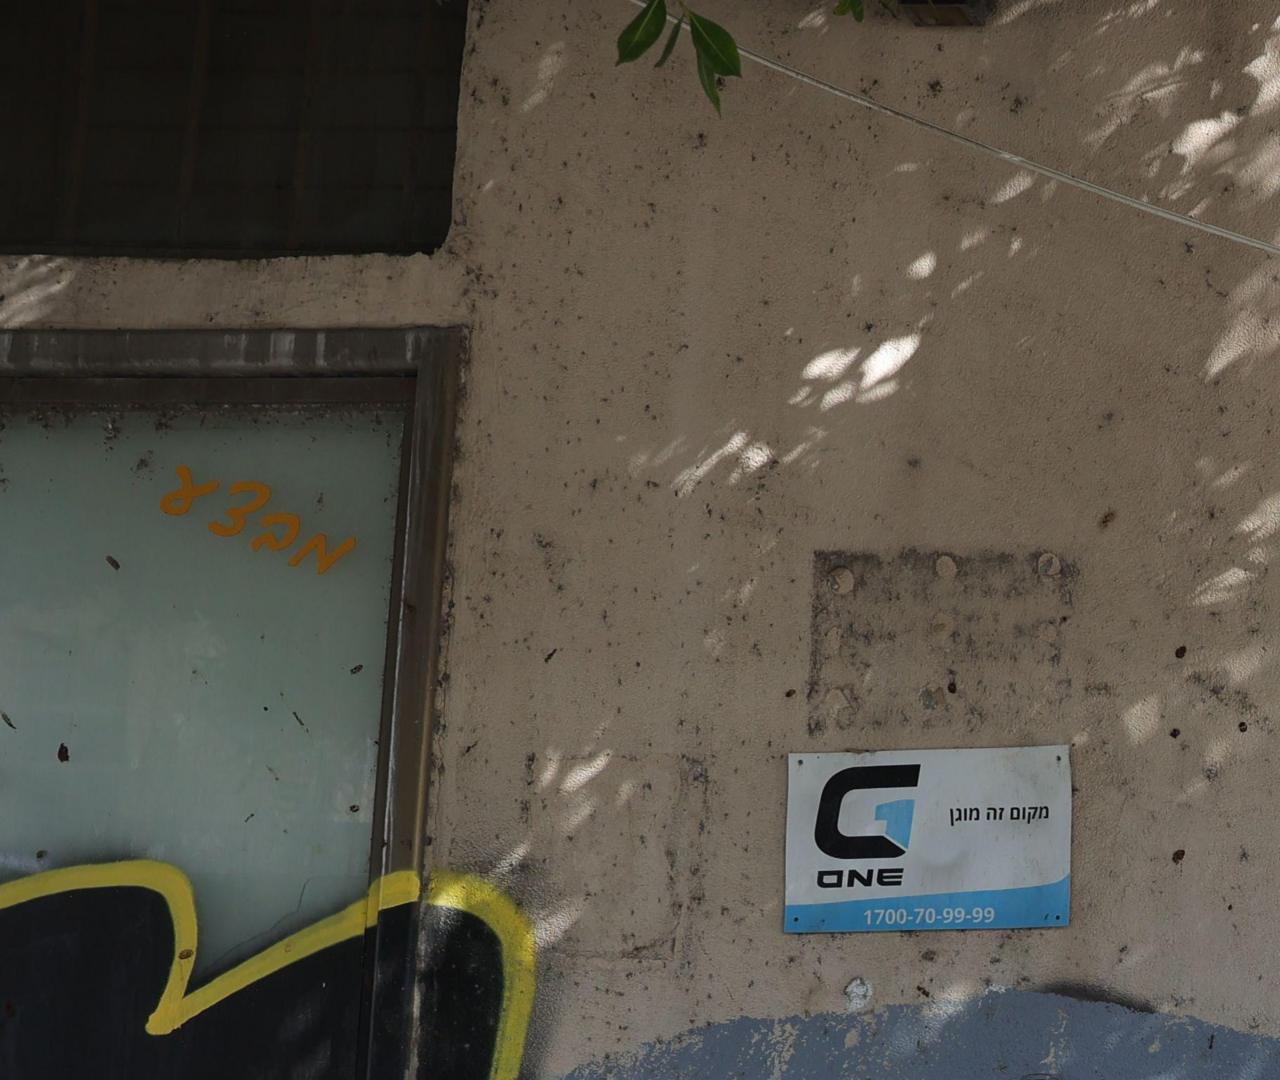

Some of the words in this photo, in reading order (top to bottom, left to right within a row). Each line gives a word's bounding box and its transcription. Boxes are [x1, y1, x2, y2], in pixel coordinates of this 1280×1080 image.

[160, 464, 358, 576] מבצע
[950, 808, 980, 826] מוגן
[986, 807, 1005, 821] זה
[1010, 806, 1049, 824] מקום
[817, 868, 904, 888] ONE
[864, 907, 995, 925] 1700-70-99-99
